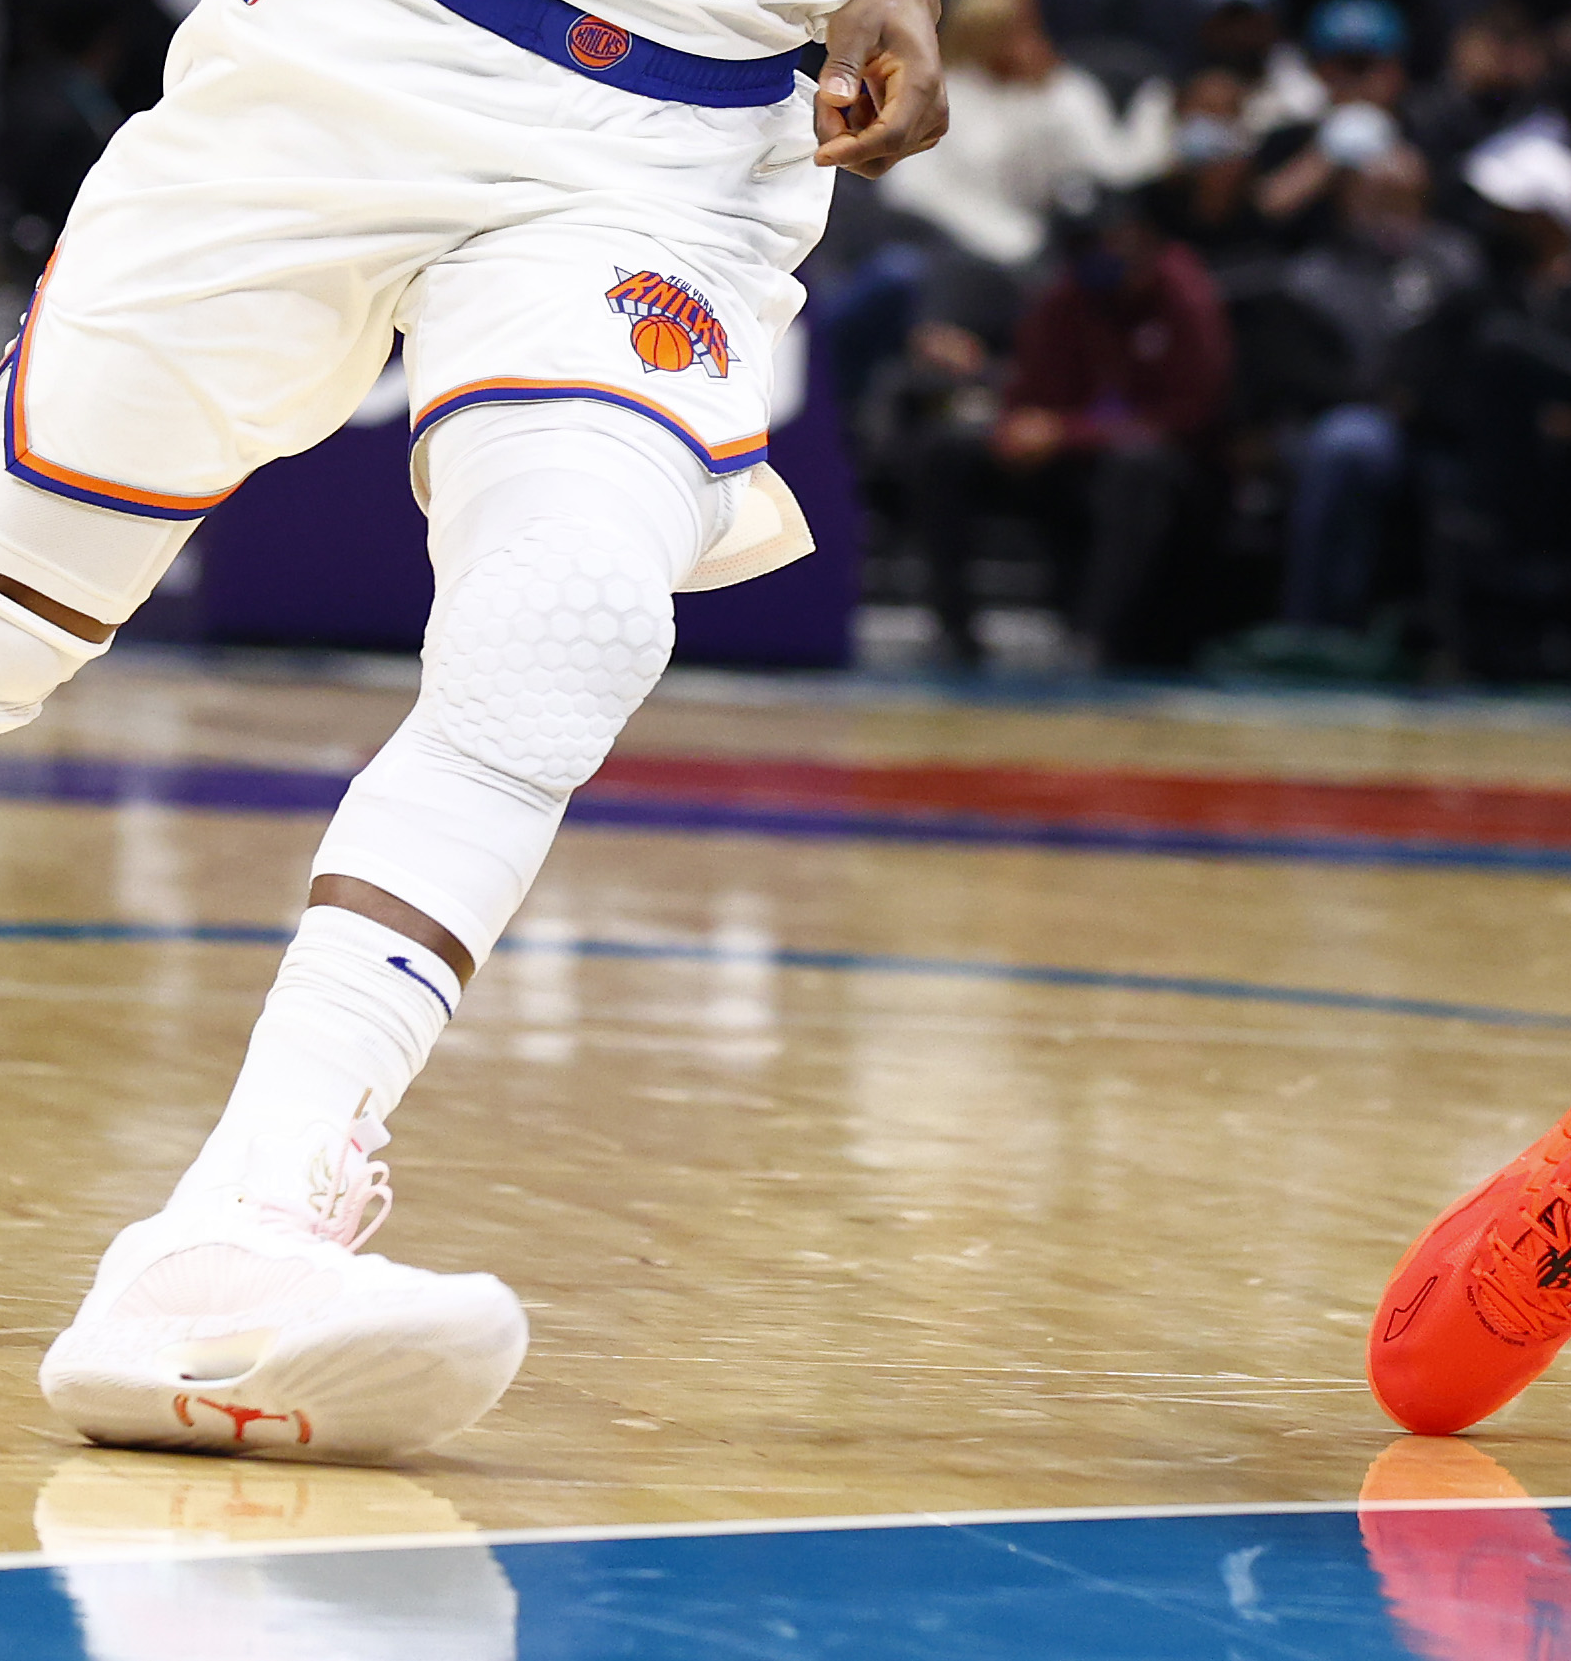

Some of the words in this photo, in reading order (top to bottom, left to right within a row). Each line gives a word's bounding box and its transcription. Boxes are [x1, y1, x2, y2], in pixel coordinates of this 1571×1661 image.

[574, 27, 623, 56] KNICKS
[666, 274, 693, 292] NEW
[692, 288, 715, 317] YORK
[604, 270, 729, 378] KNICKS
